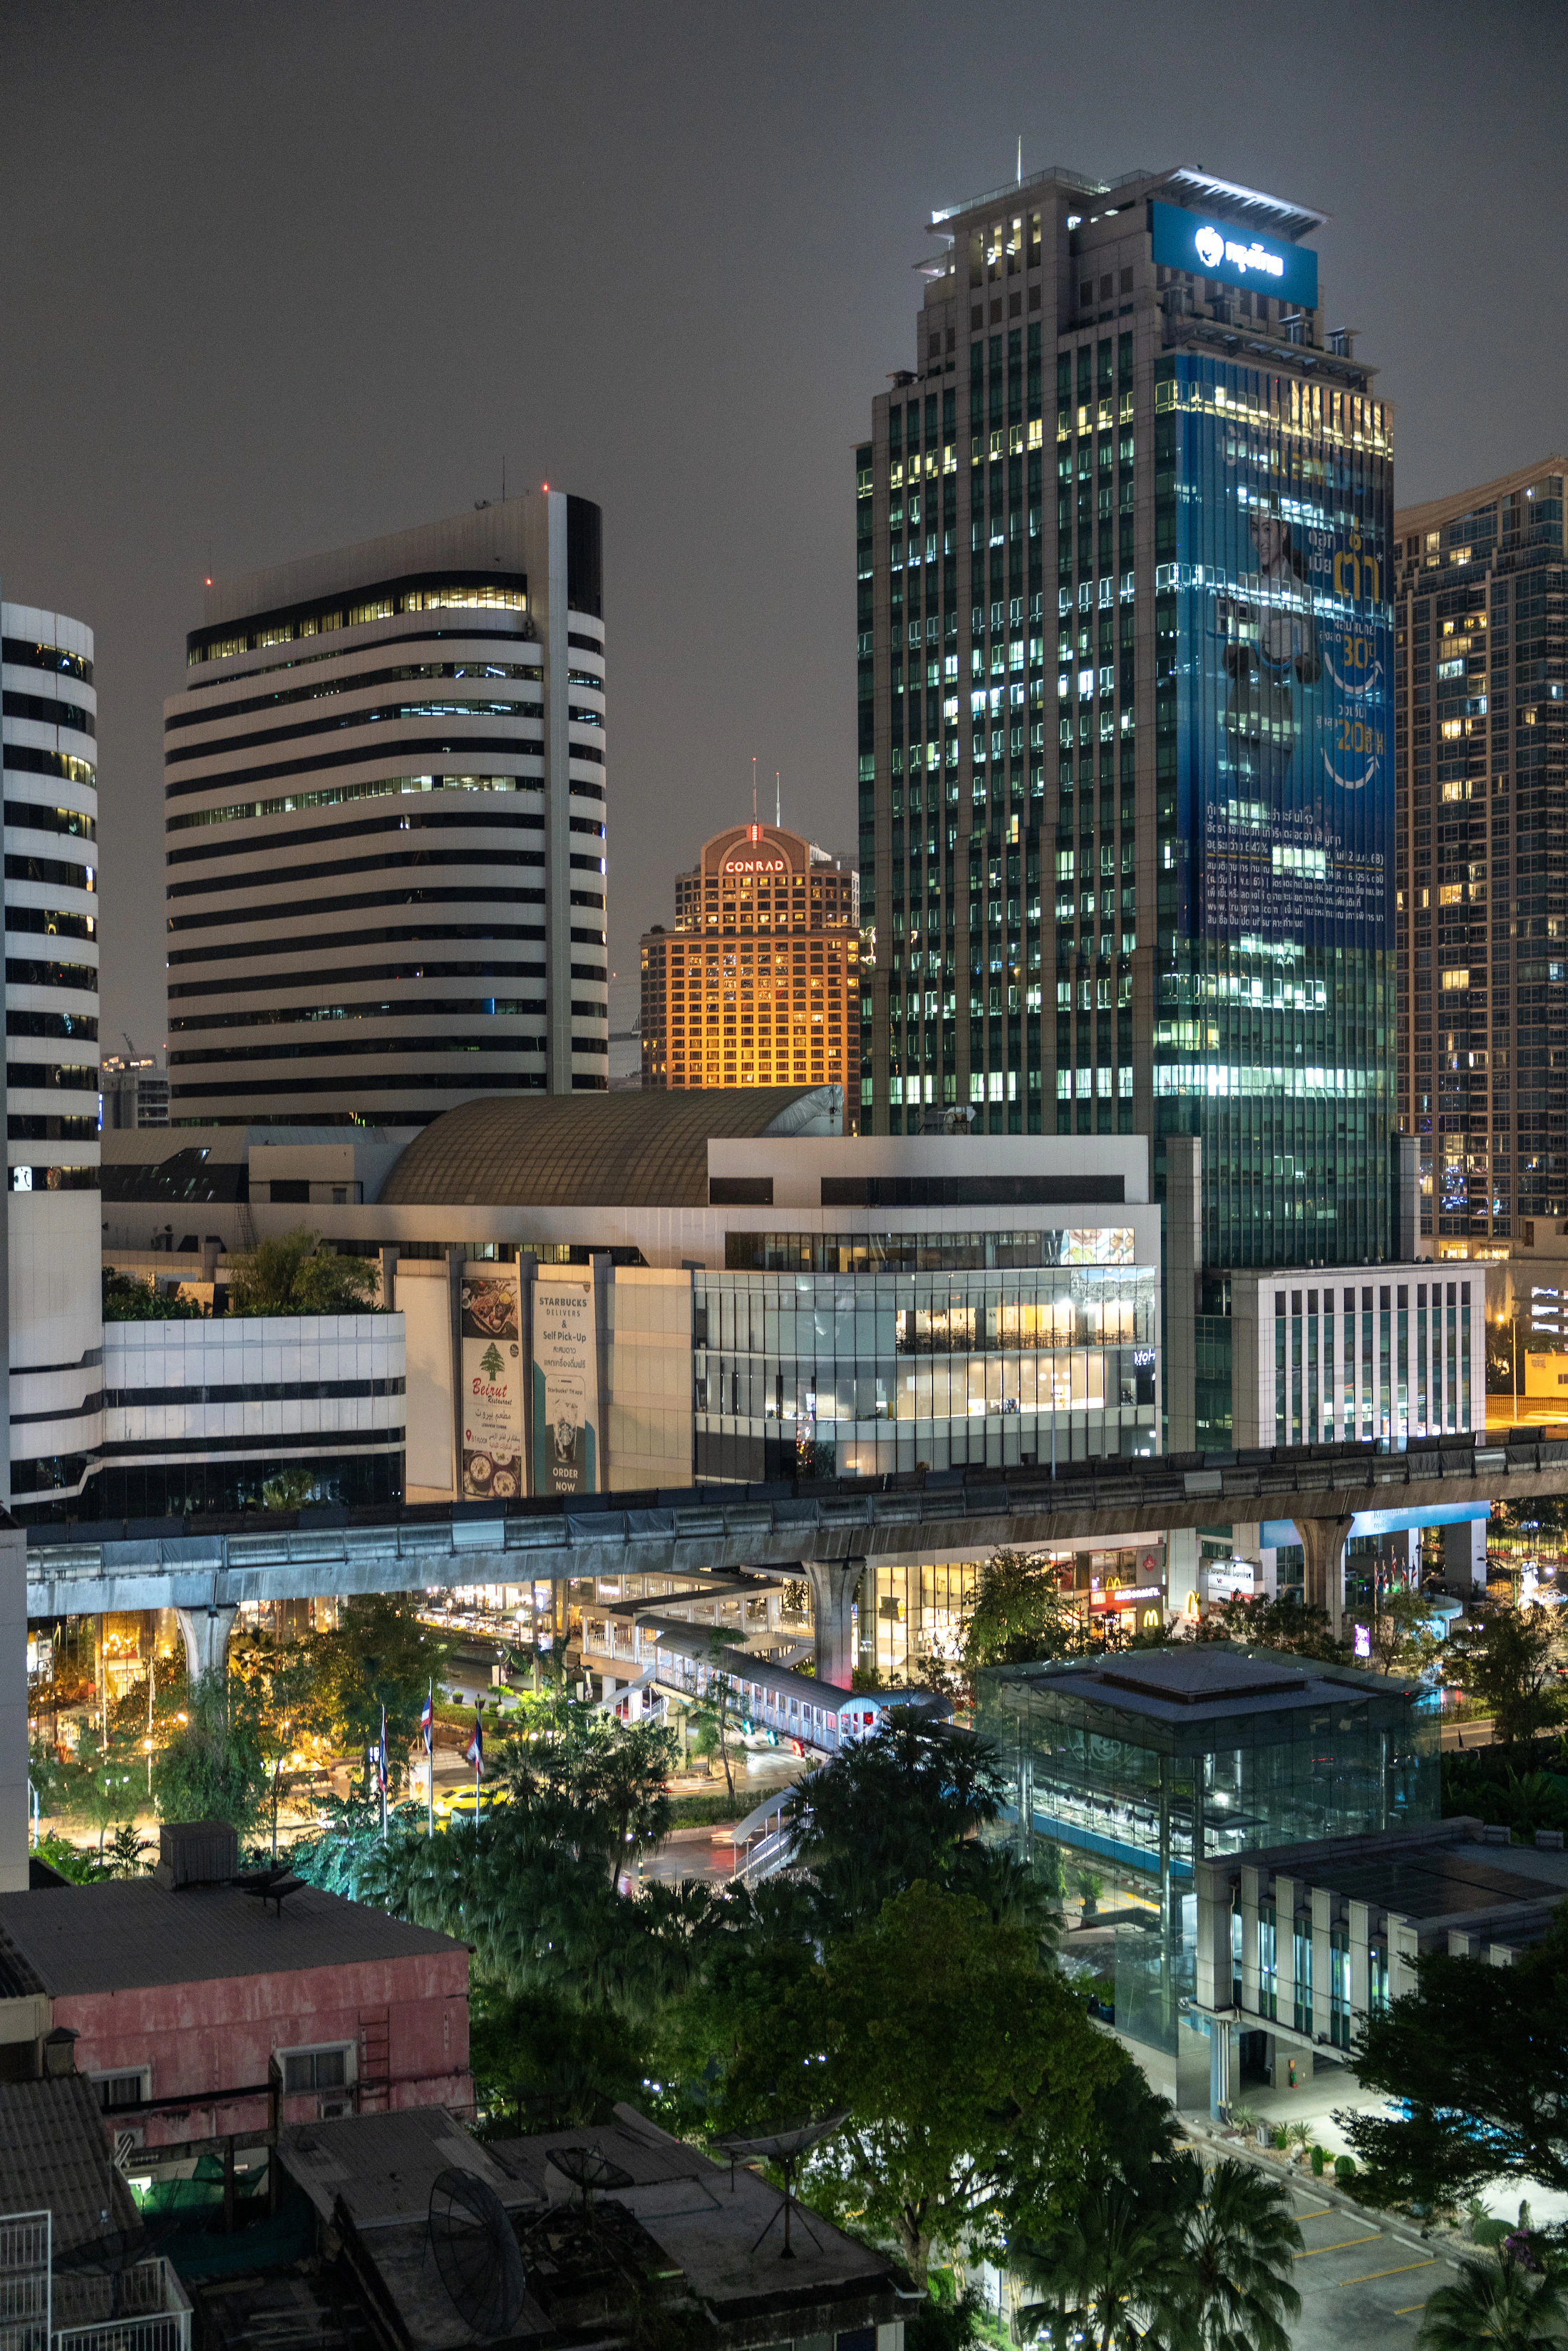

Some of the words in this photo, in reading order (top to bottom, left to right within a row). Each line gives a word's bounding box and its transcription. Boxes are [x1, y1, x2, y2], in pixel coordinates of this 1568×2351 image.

[1342, 634, 1368, 669] 30
[1338, 719, 1364, 753] 20
[1245, 842, 1268, 854] 647%
[726, 860, 784, 873] CONRAD
[540, 1297, 587, 1307] STARBUCKS
[546, 1309, 580, 1317] DELIVERS
[562, 1319, 567, 1328] &
[543, 1331, 556, 1341] Self
[472, 1377, 507, 1398] Beirut
[488, 1395, 512, 1406] Restaurant
[552, 1467, 578, 1478] ORDER
[555, 1481, 575, 1493] NOW
